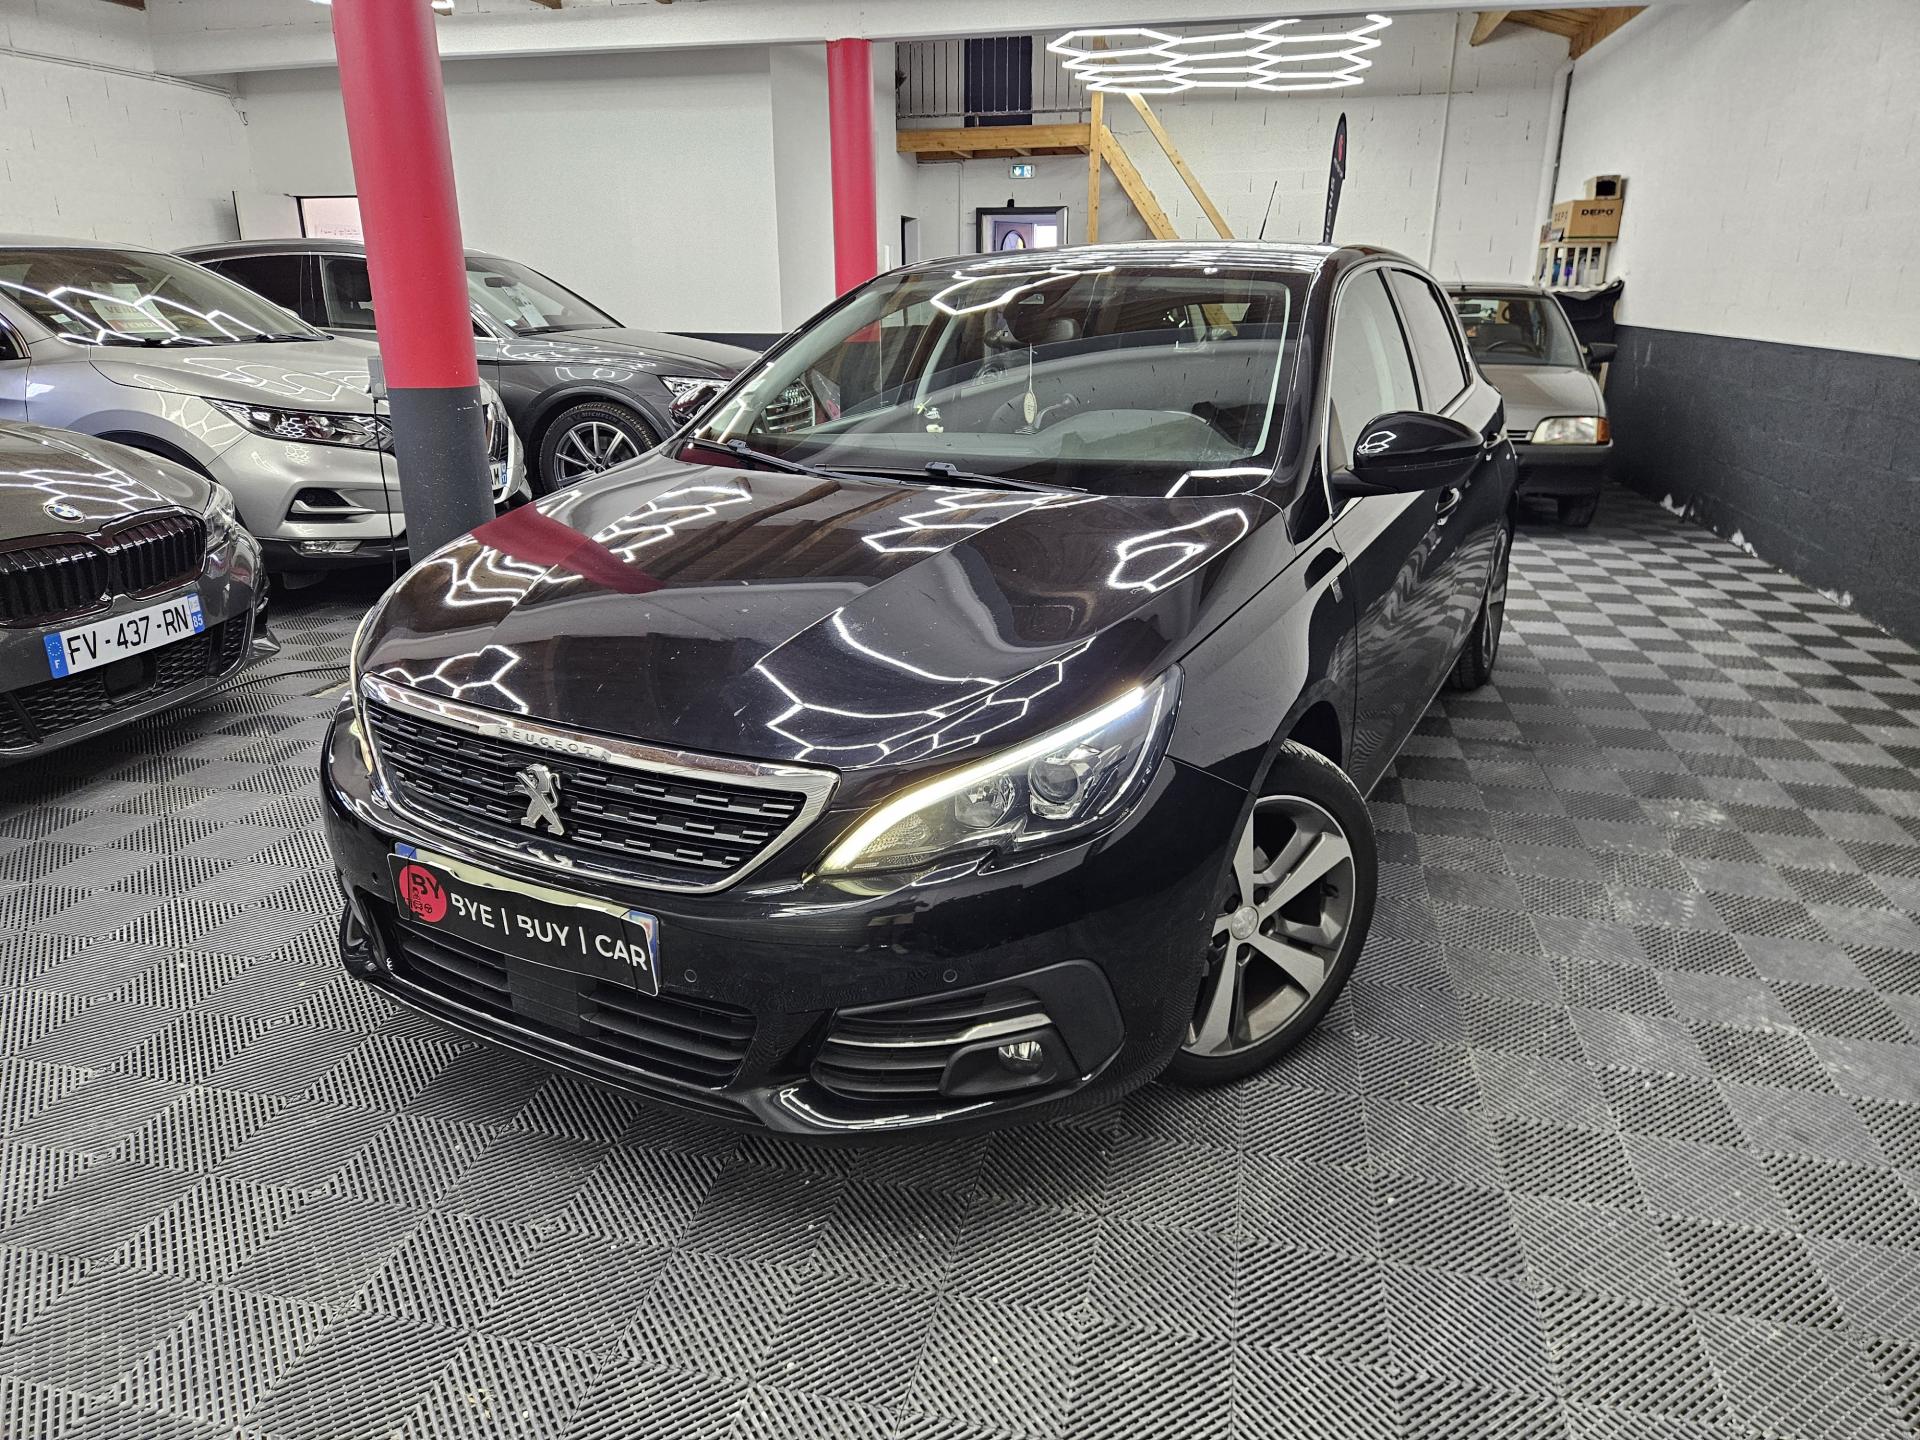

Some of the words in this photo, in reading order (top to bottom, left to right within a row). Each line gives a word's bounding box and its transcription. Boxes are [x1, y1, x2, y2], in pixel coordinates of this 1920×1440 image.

[1581, 208, 1615, 216] DEPO
[192, 613, 204, 628] 85
[54, 659, 61, 670] F
[499, 726, 595, 756] PEUGEOT
[410, 872, 441, 900] BY
[450, 892, 495, 928] BYE
[516, 914, 569, 947] BUY
[594, 934, 648, 971] CAR
